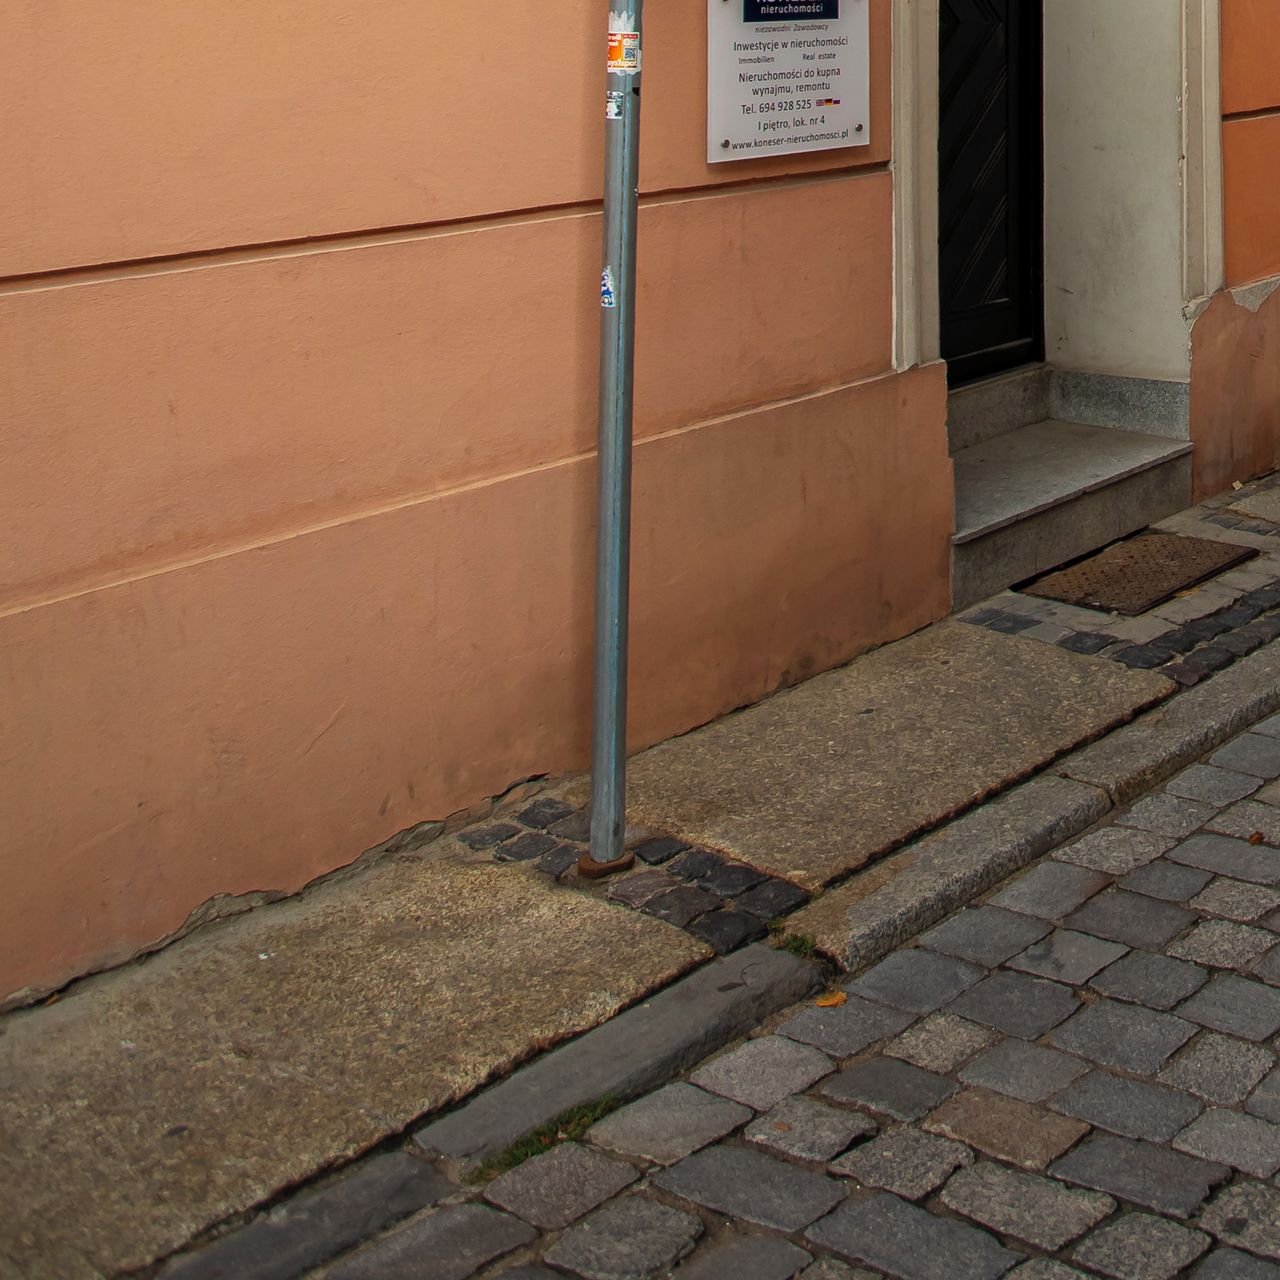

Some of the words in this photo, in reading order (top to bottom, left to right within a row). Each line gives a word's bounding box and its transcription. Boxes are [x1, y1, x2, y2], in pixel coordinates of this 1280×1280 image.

[760, 3, 823, 14] nieruchomości
[733, 39, 779, 52] Inwestycje
[790, 36, 848, 49] nieruchomości
[739, 55, 775, 65] Immobilien
[802, 53, 815, 61] Real
[818, 52, 836, 60] estate
[739, 69, 802, 83] Nieruchomości
[804, 69, 814, 79] do
[816, 66, 841, 80] kupna
[752, 85, 794, 97] wynajmu,
[795, 82, 830, 92] remontu
[741, 104, 757, 115] Tel.
[759, 102, 775, 113] 694
[777, 100, 794, 112] 928
[796, 99, 812, 110] 525
[763, 119, 790, 132] piętro,
[792, 116, 807, 127] lok.
[809, 117, 819, 125] nr
[820, 115, 825, 124] 4
